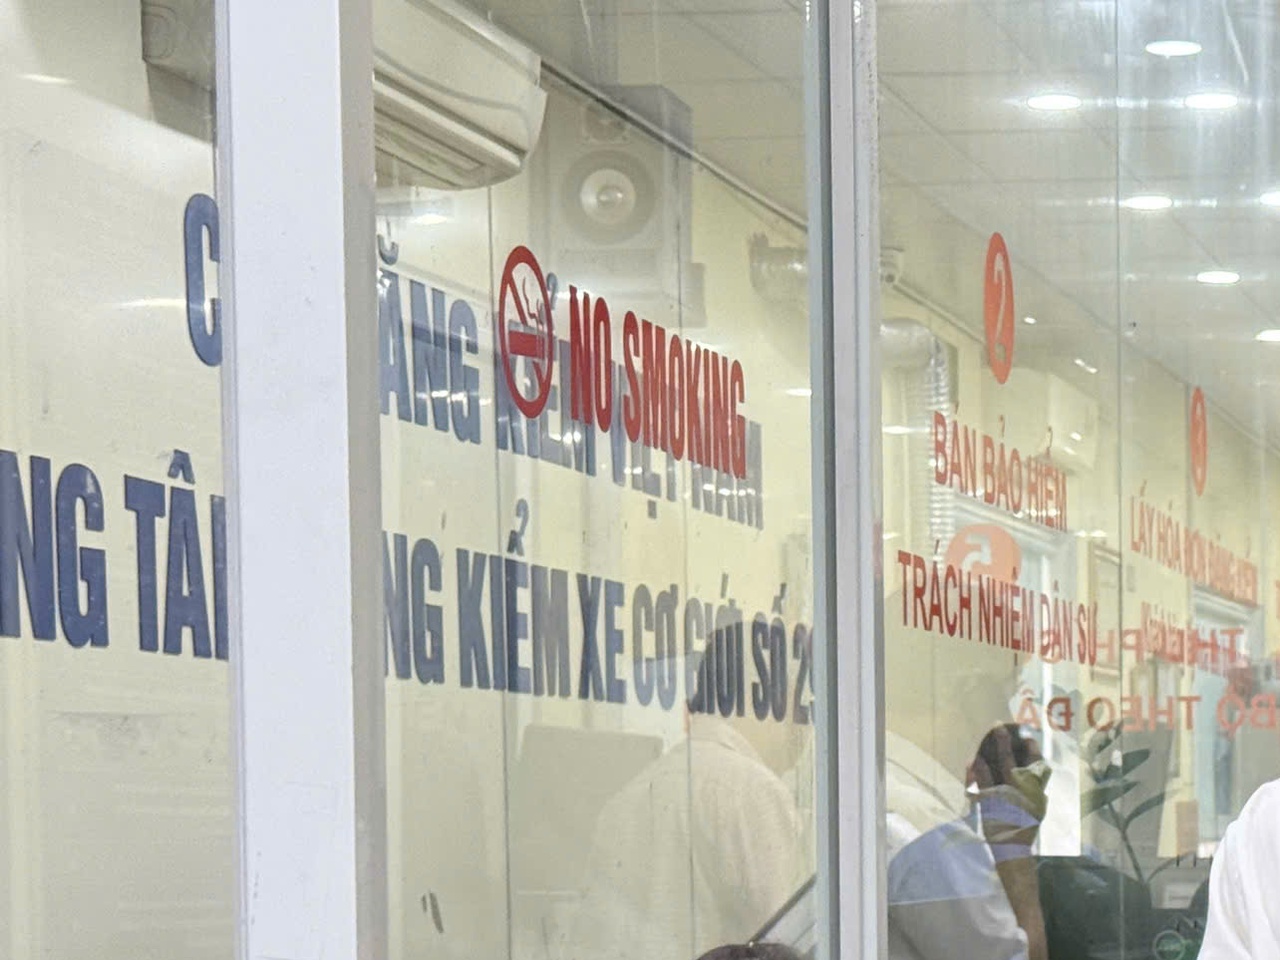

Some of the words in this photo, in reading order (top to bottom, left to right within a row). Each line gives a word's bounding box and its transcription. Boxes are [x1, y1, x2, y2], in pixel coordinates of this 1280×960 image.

[377, 222, 481, 445] ĂNG
[569, 284, 612, 433] NO
[623, 310, 747, 480] SMOKING
[0, 449, 109, 648] NG
[382, 530, 445, 685] NG
[456, 498, 571, 699] KIỂM
[576, 572, 627, 704] XE
[631, 583, 679, 711] CƠ
[684, 573, 746, 719] GIỚI
[752, 583, 788, 724] SỐ
[793, 622, 814, 725] 2
[898, 539, 972, 640] TRÁCH
[978, 567, 1034, 667] NHIỆM
